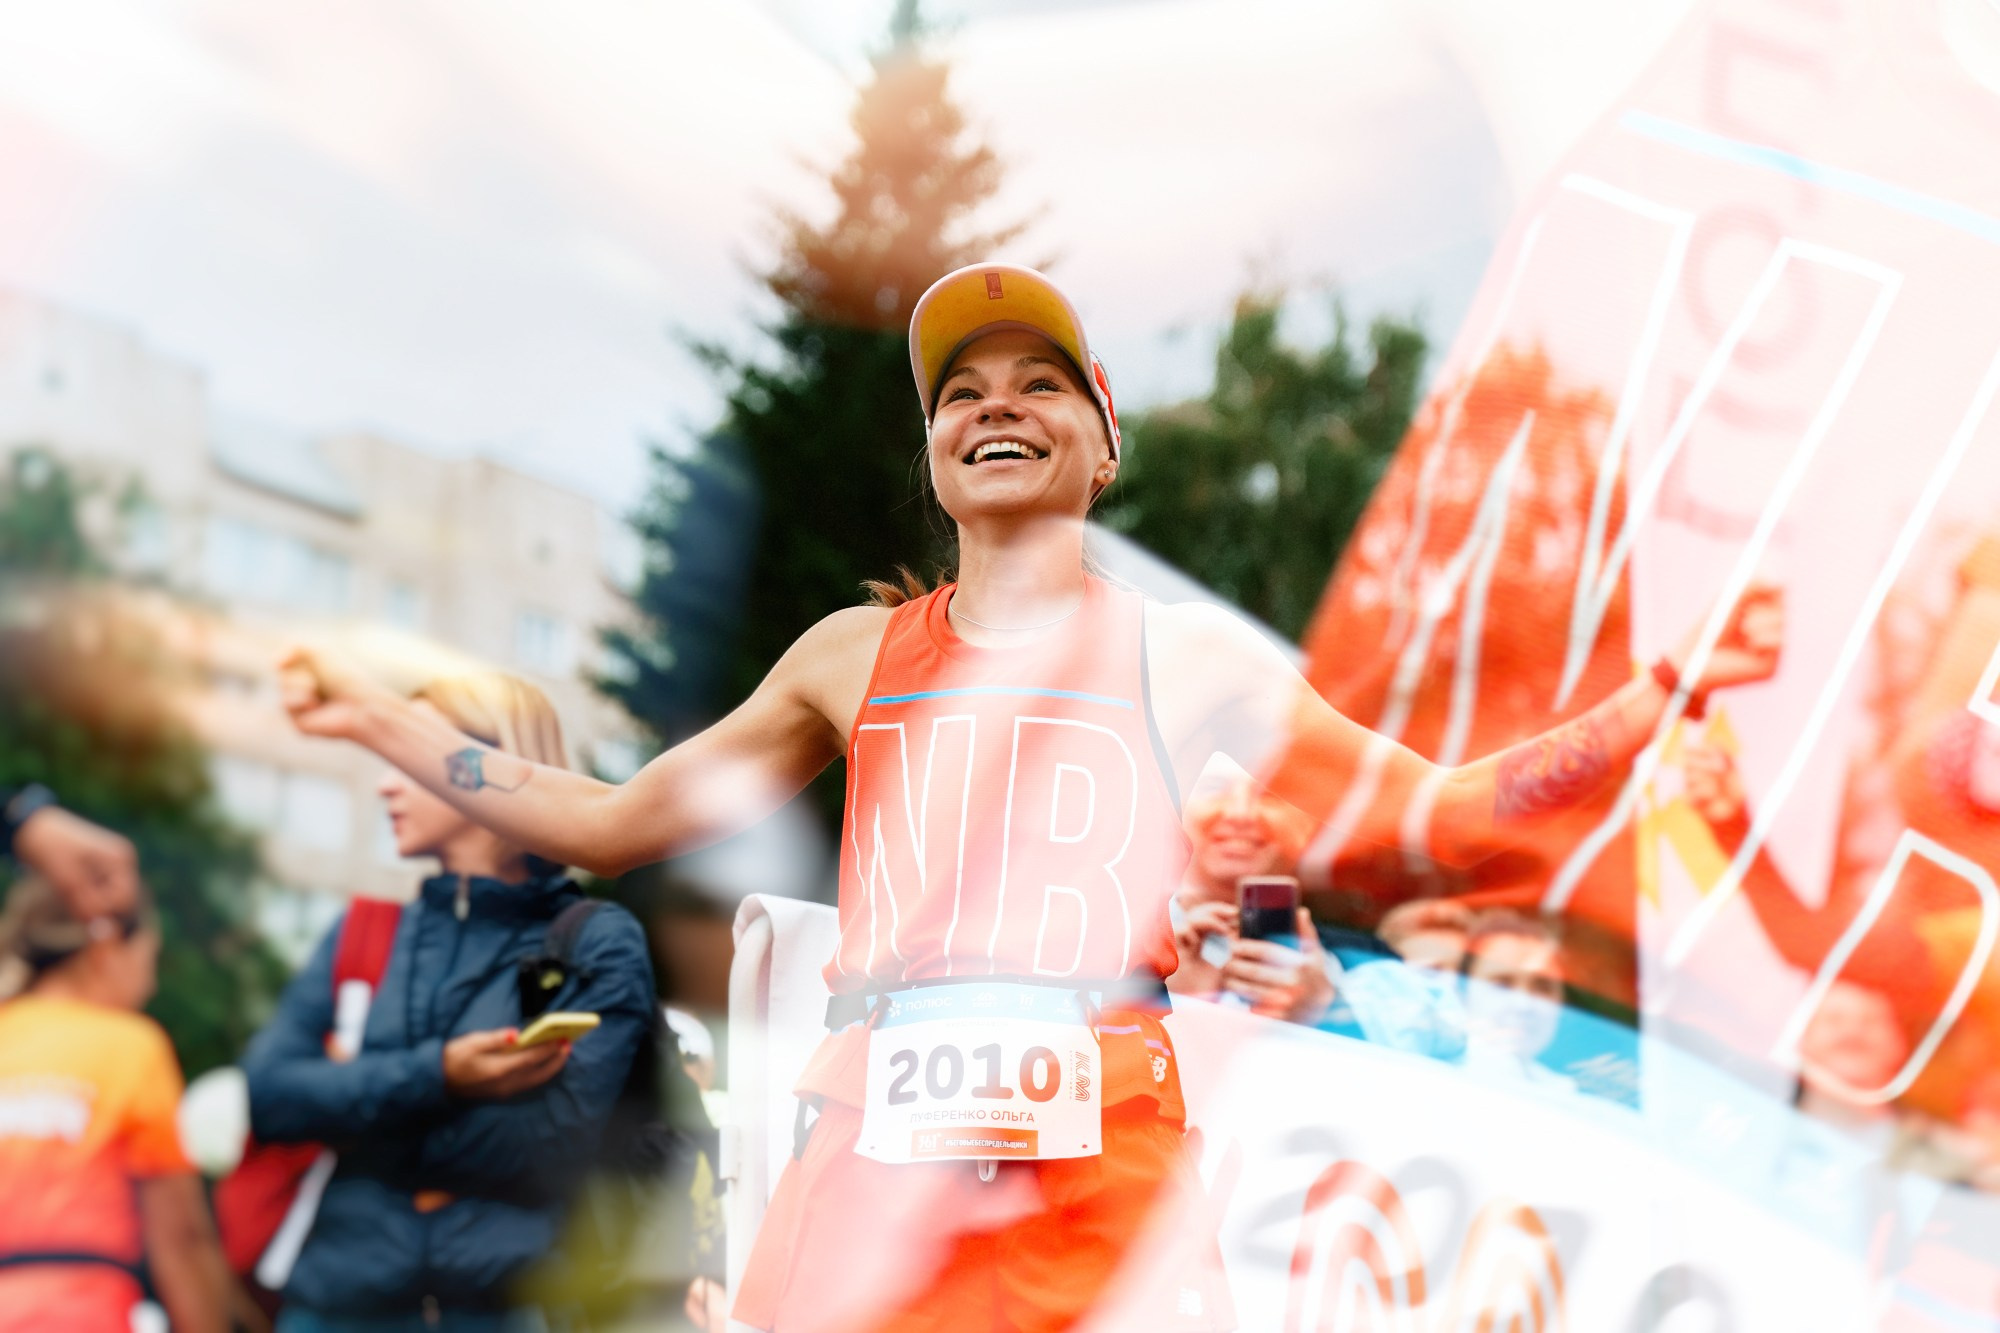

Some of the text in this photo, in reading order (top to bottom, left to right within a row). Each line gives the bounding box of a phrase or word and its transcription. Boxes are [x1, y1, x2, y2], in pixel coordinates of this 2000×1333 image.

[837, 715, 1138, 982] NB
[905, 996, 953, 1012] ПОЛЮС
[888, 1042, 1062, 1106] 2010
[909, 1109, 1035, 1123] ЛУФЕРЕНКО ОЛЬГА
